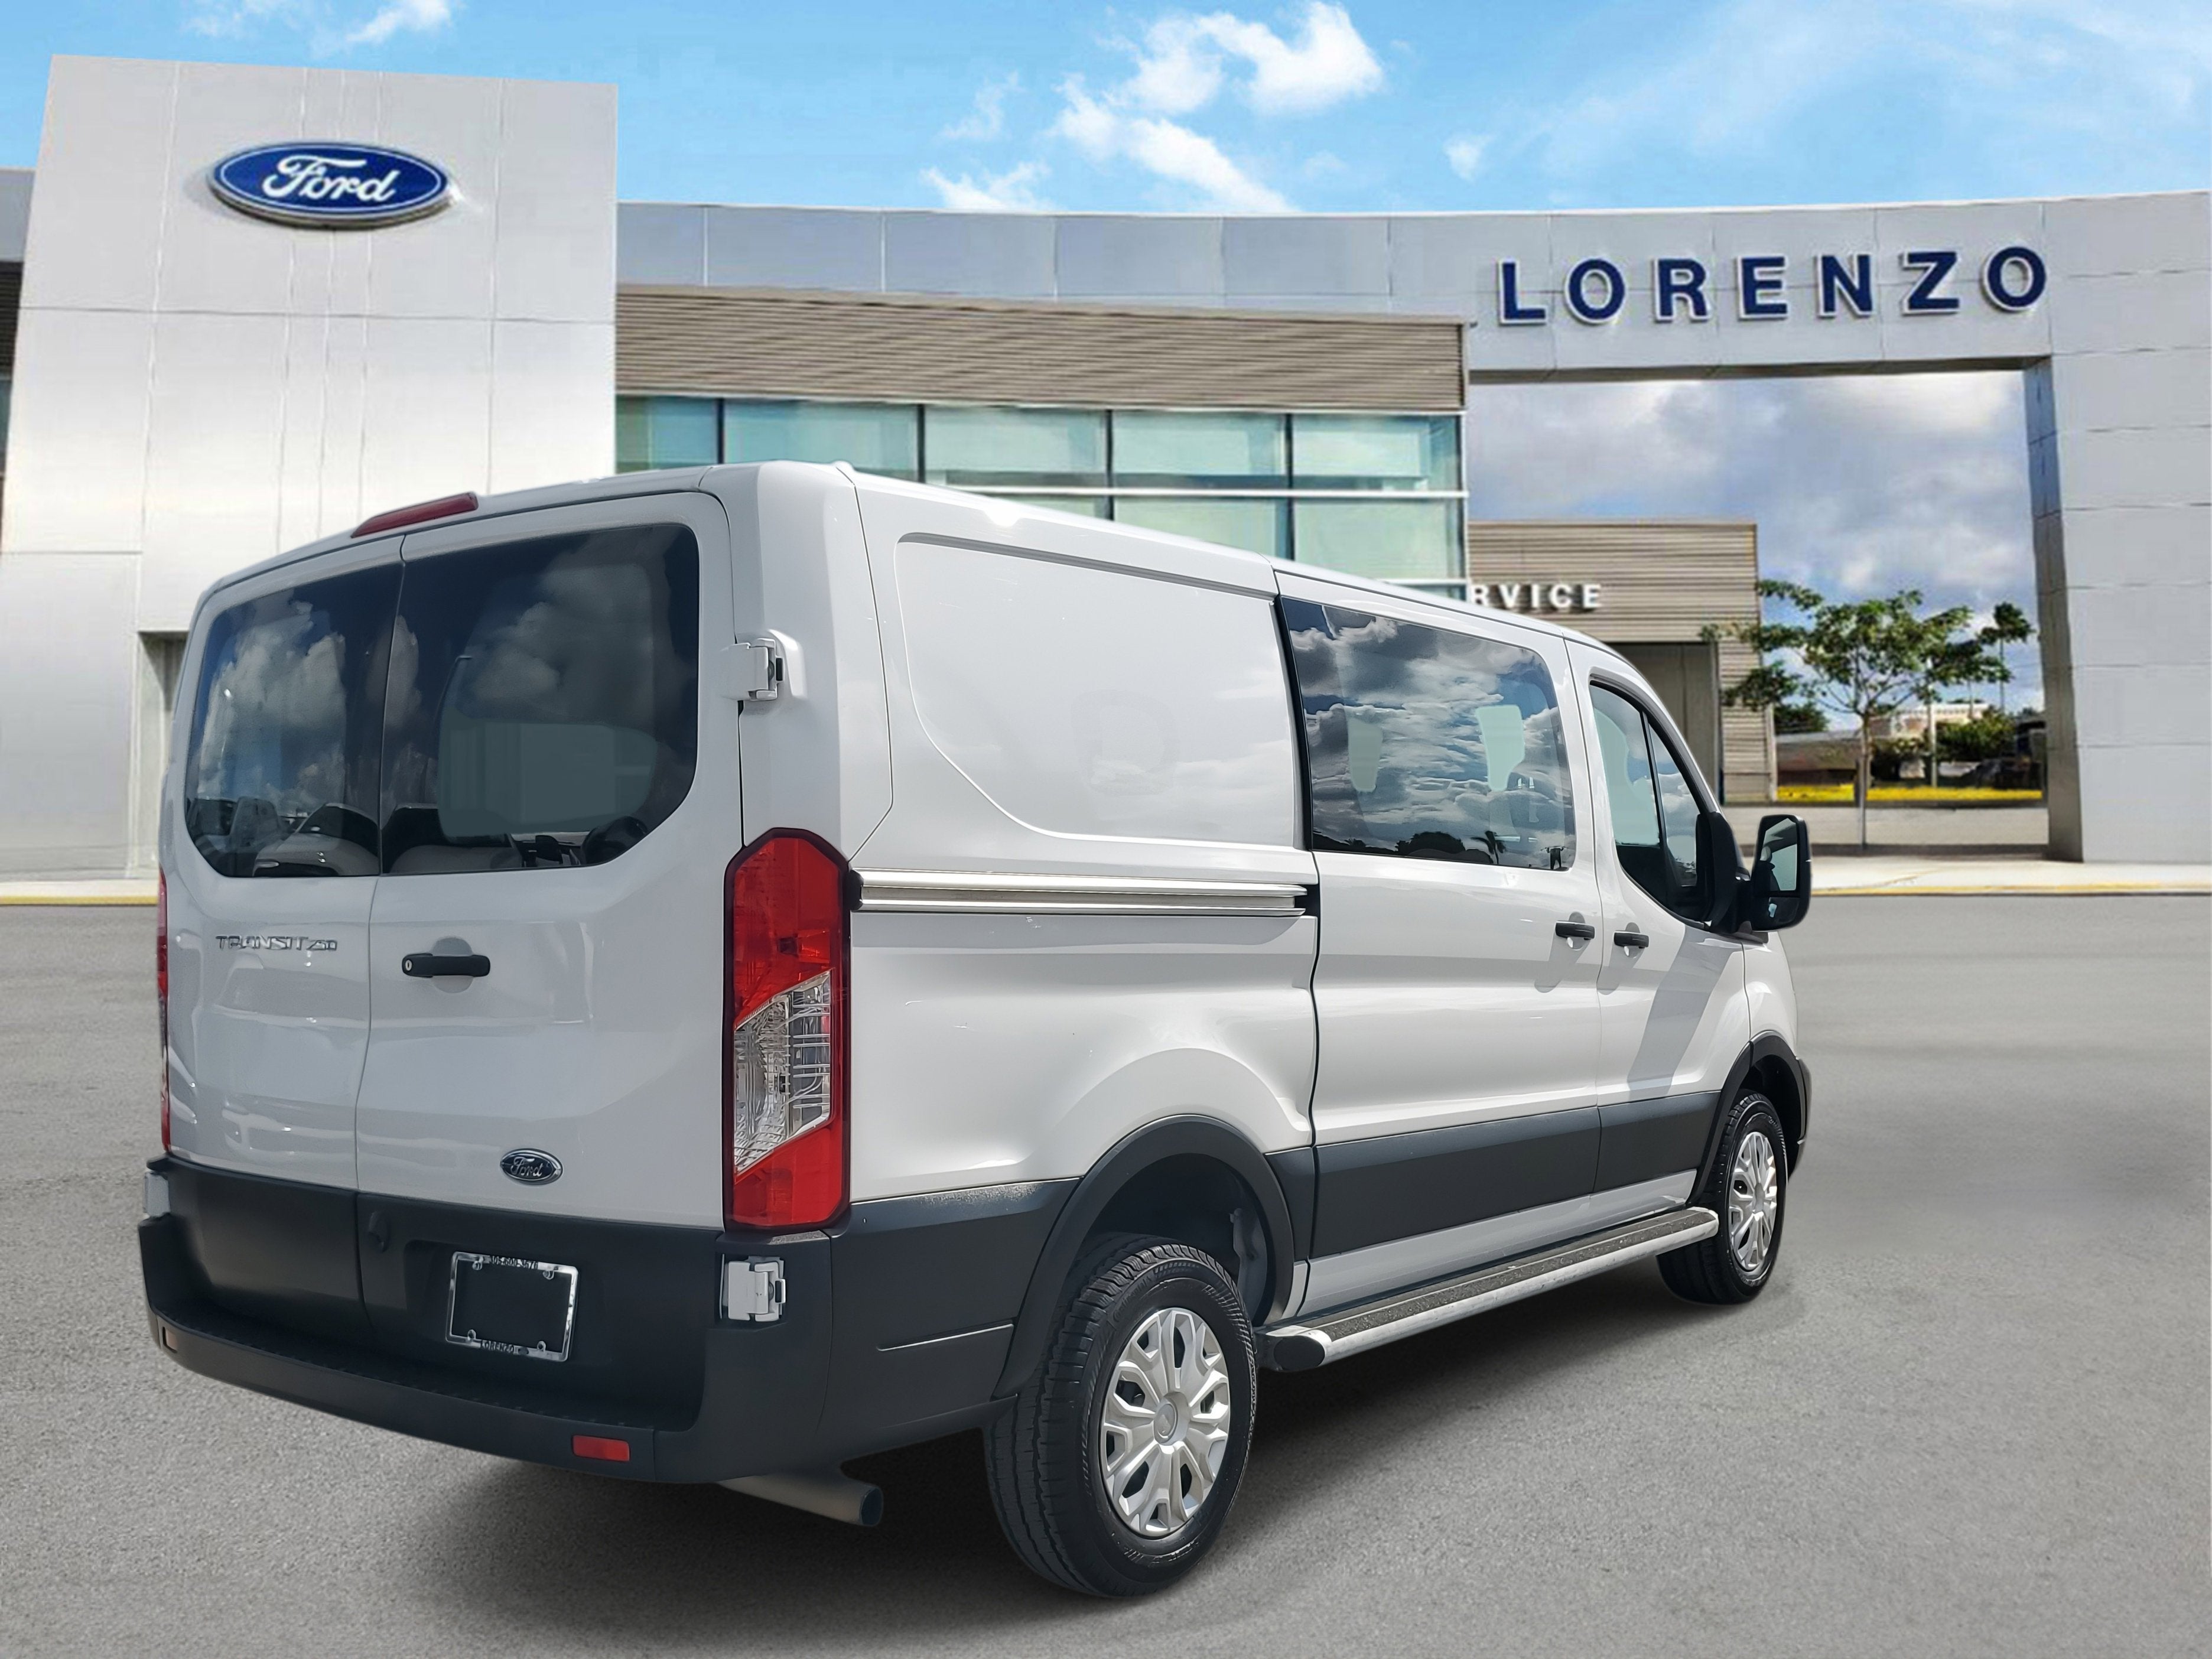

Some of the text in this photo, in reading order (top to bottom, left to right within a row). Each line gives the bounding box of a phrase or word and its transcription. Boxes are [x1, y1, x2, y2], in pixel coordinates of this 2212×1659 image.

[262, 155, 400, 201] Ford
[1498, 246, 2048, 325] LORENZO
[216, 936, 309, 951] TRANSIT
[510, 1156, 544, 1177] Ford
